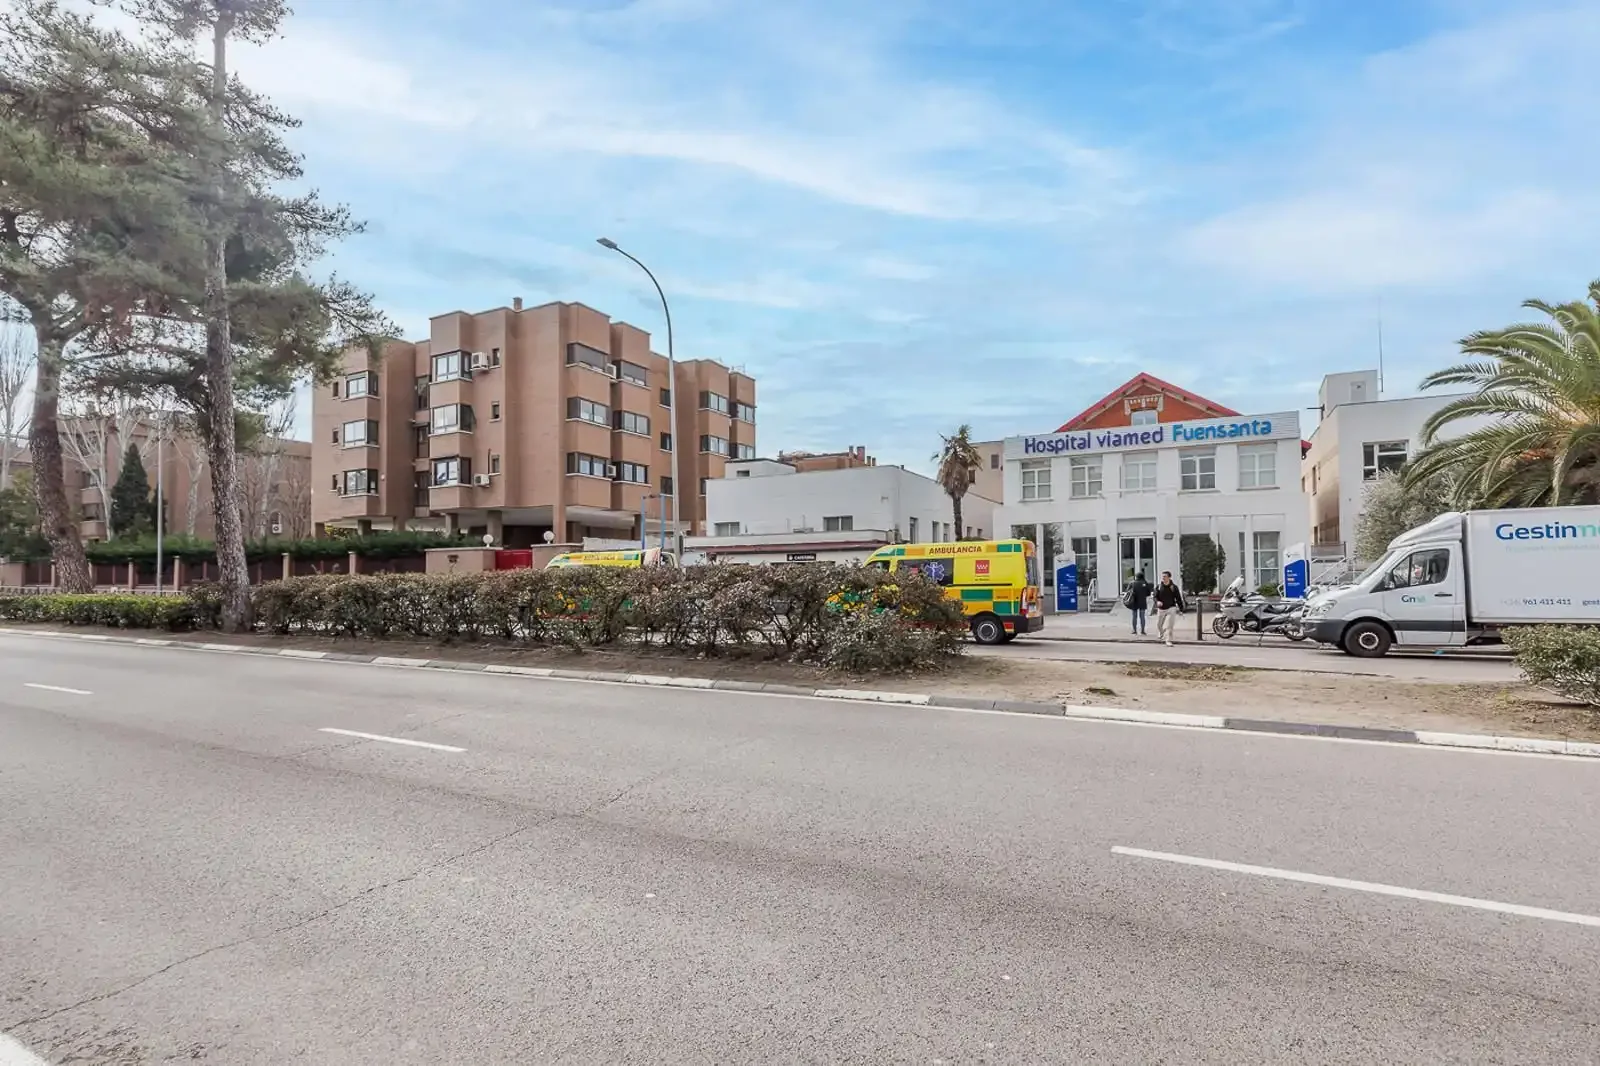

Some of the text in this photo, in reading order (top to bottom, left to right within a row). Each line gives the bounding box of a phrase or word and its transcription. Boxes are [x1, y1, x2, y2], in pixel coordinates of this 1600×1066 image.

[1024, 419, 1272, 454] Hospital viamed Fuensanta
[1495, 521, 1600, 540] Gestinm
[929, 545, 982, 555] AMBULANCIA
